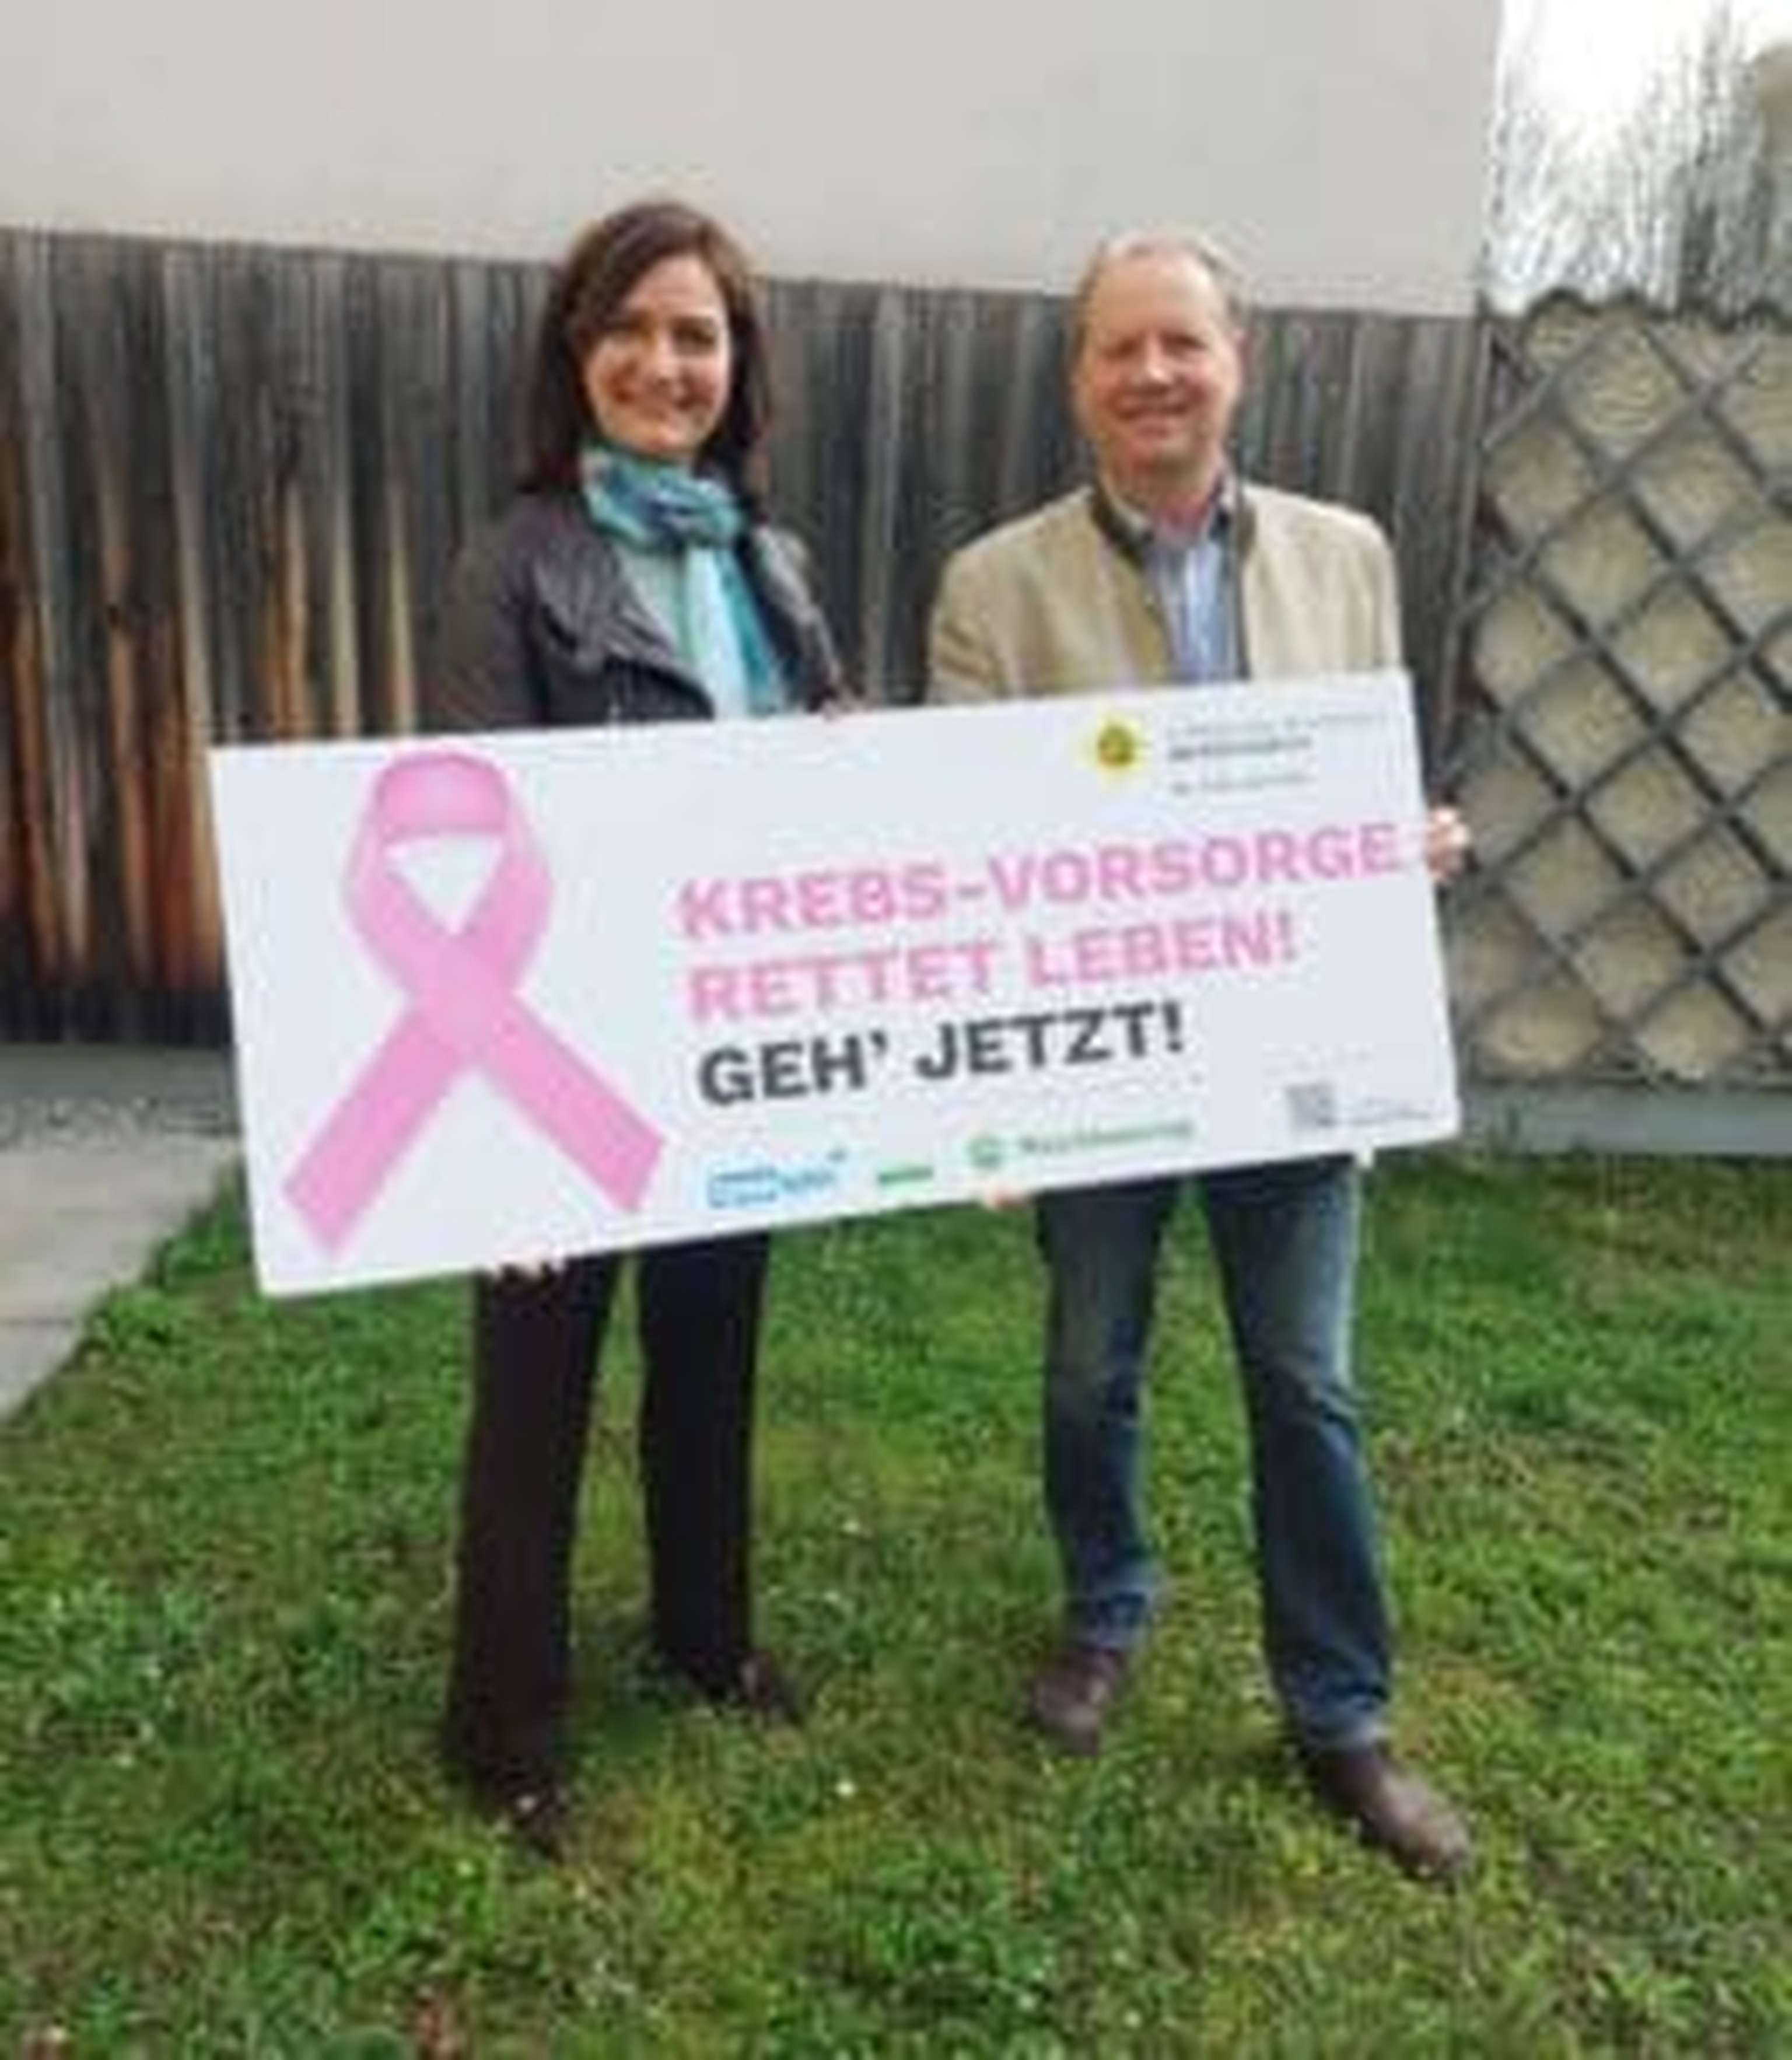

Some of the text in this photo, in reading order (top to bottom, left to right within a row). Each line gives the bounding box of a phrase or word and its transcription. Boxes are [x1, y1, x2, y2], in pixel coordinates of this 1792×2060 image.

[677, 820, 1401, 938] KREBS-VORSORGE
[688, 911, 1298, 1022] RETTET LEBEN!
[696, 1001, 1184, 1105] GEH' JETZT!
